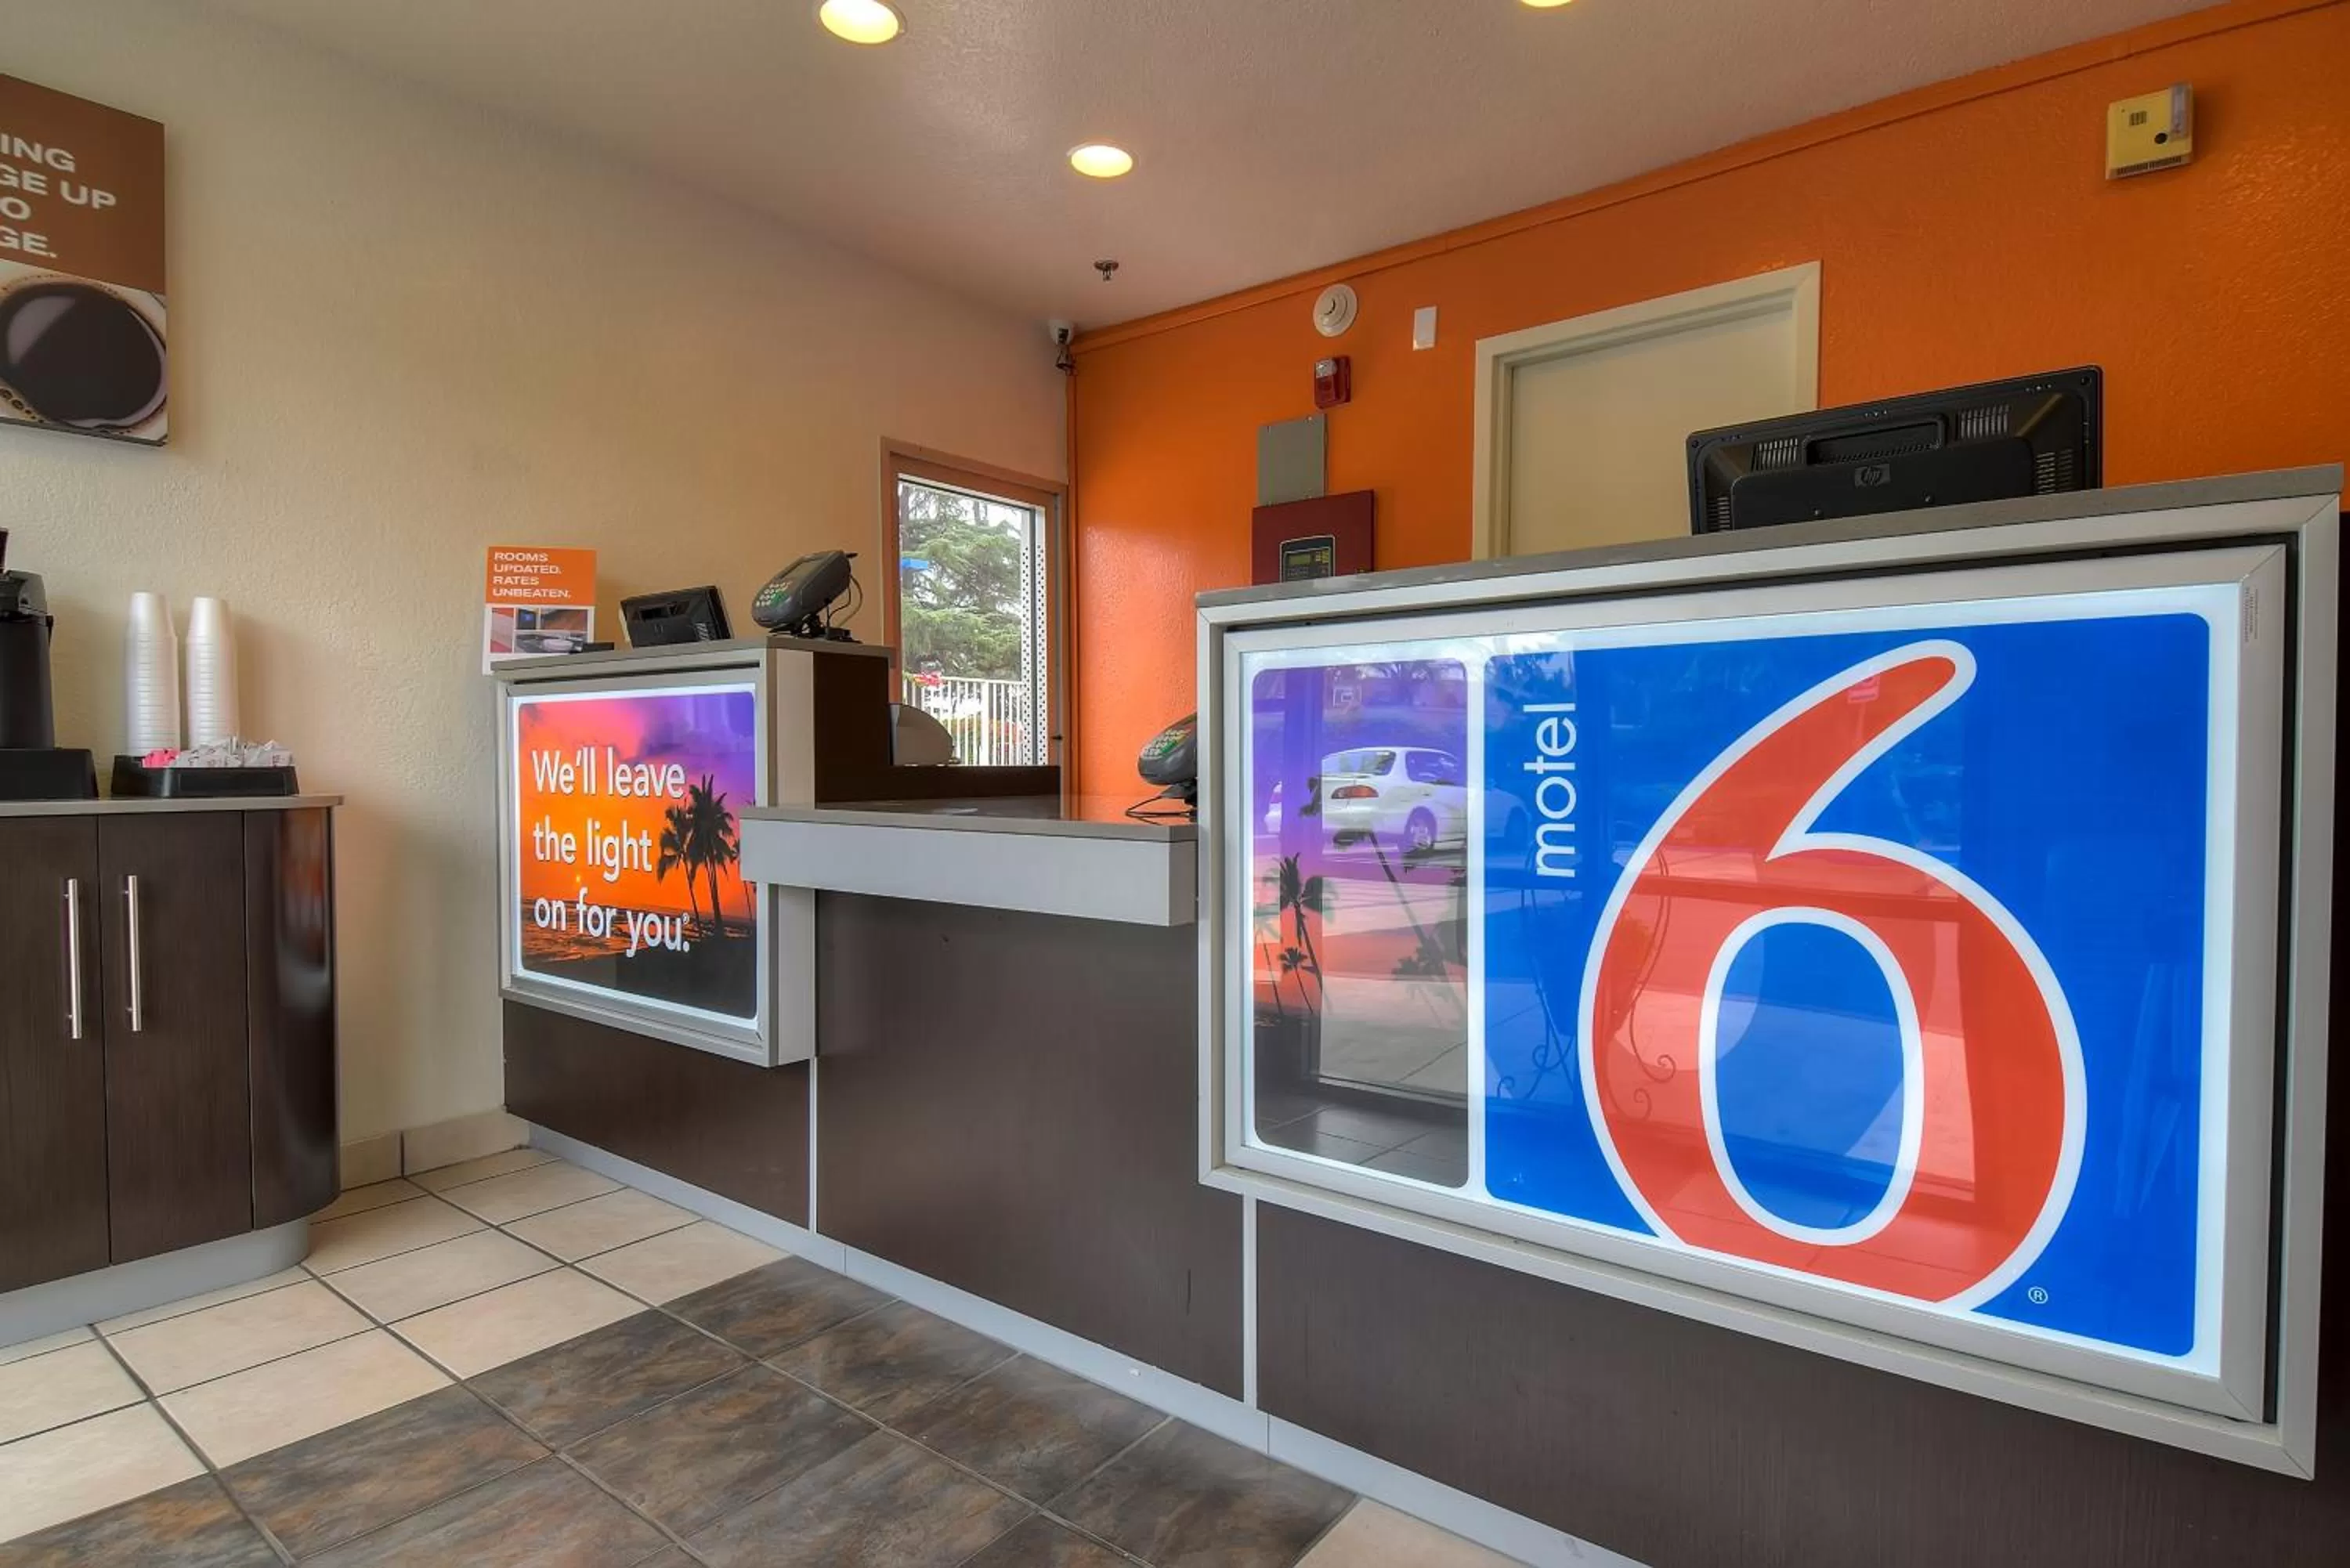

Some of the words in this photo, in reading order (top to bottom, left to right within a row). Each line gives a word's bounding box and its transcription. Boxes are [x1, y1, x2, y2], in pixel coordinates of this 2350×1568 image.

[1, 133, 75, 173] ING
[60, 179, 117, 209] UP
[493, 576, 540, 586] RATES
[494, 563, 562, 574] UPDATED.
[492, 588, 572, 599] UNBEATEN.
[532, 746, 596, 795] We'll
[607, 746, 685, 798] leave
[1523, 702, 1577, 878] motel
[533, 815, 577, 864] the
[588, 818, 653, 883] light
[533, 897, 567, 931] on
[576, 887, 616, 938] for
[1578, 638, 2088, 1312] 6
